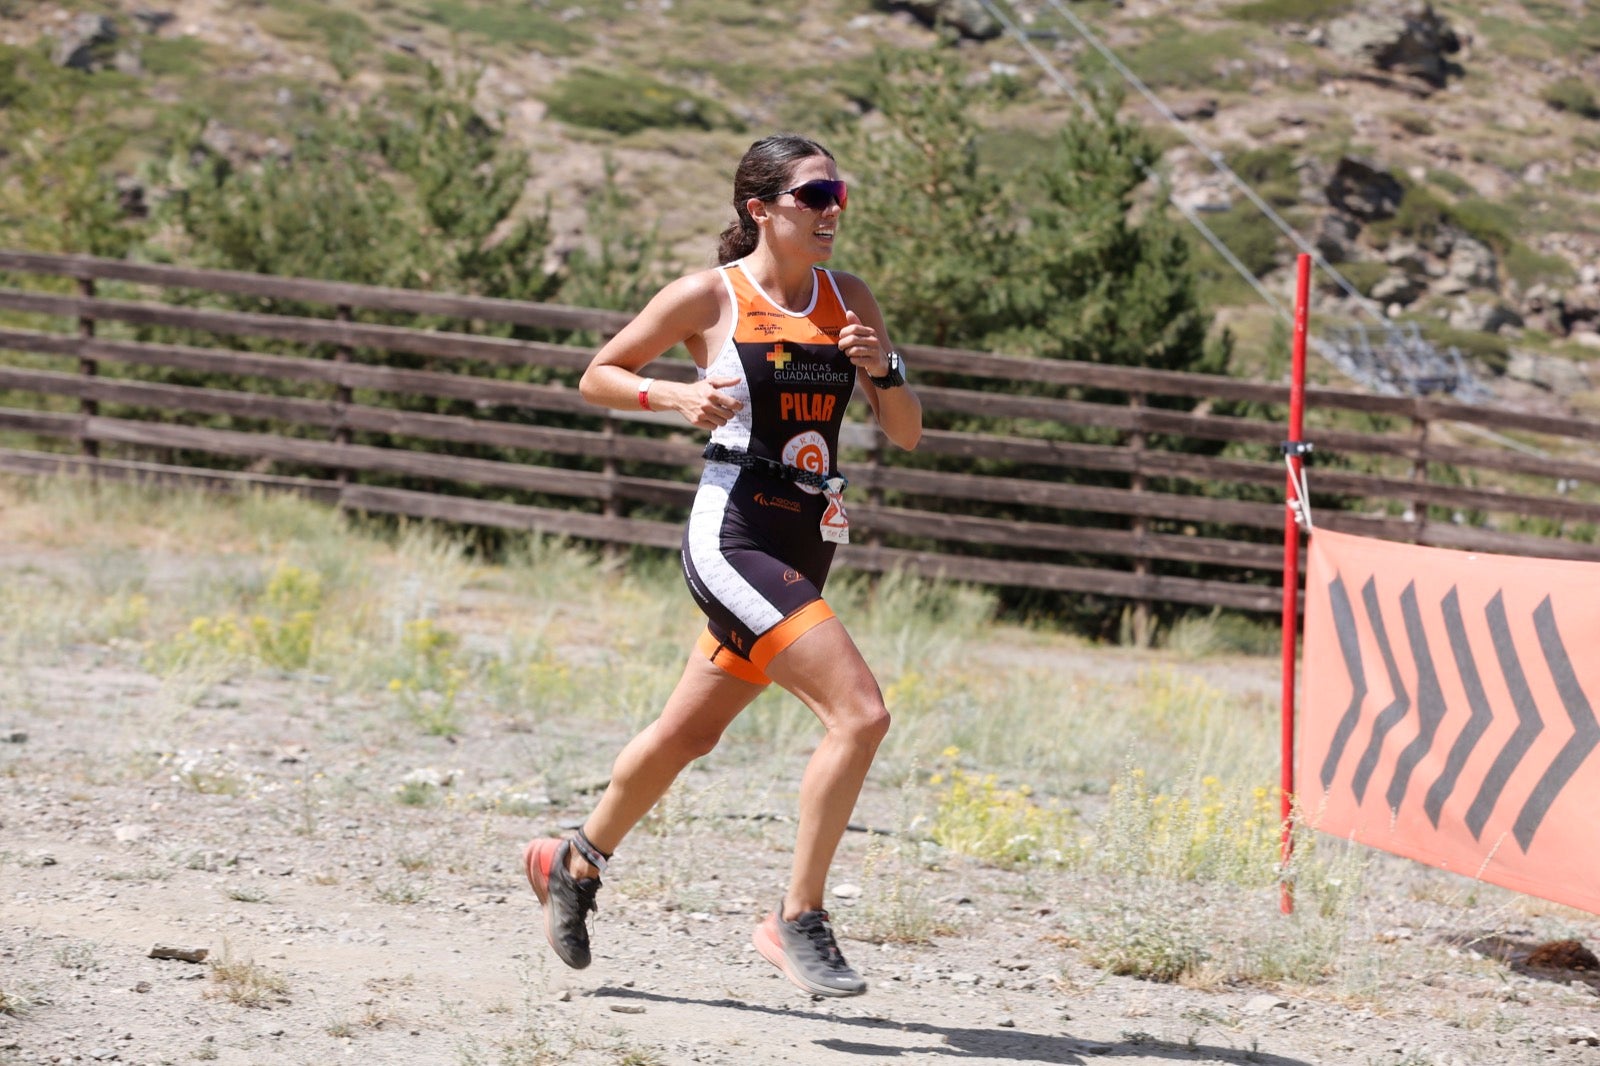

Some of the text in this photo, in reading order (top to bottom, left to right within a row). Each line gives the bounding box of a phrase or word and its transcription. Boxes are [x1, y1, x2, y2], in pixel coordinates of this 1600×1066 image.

[774, 370, 849, 383] GUADALHORCE
[780, 392, 836, 422] PILAR
[802, 451, 819, 472] G
